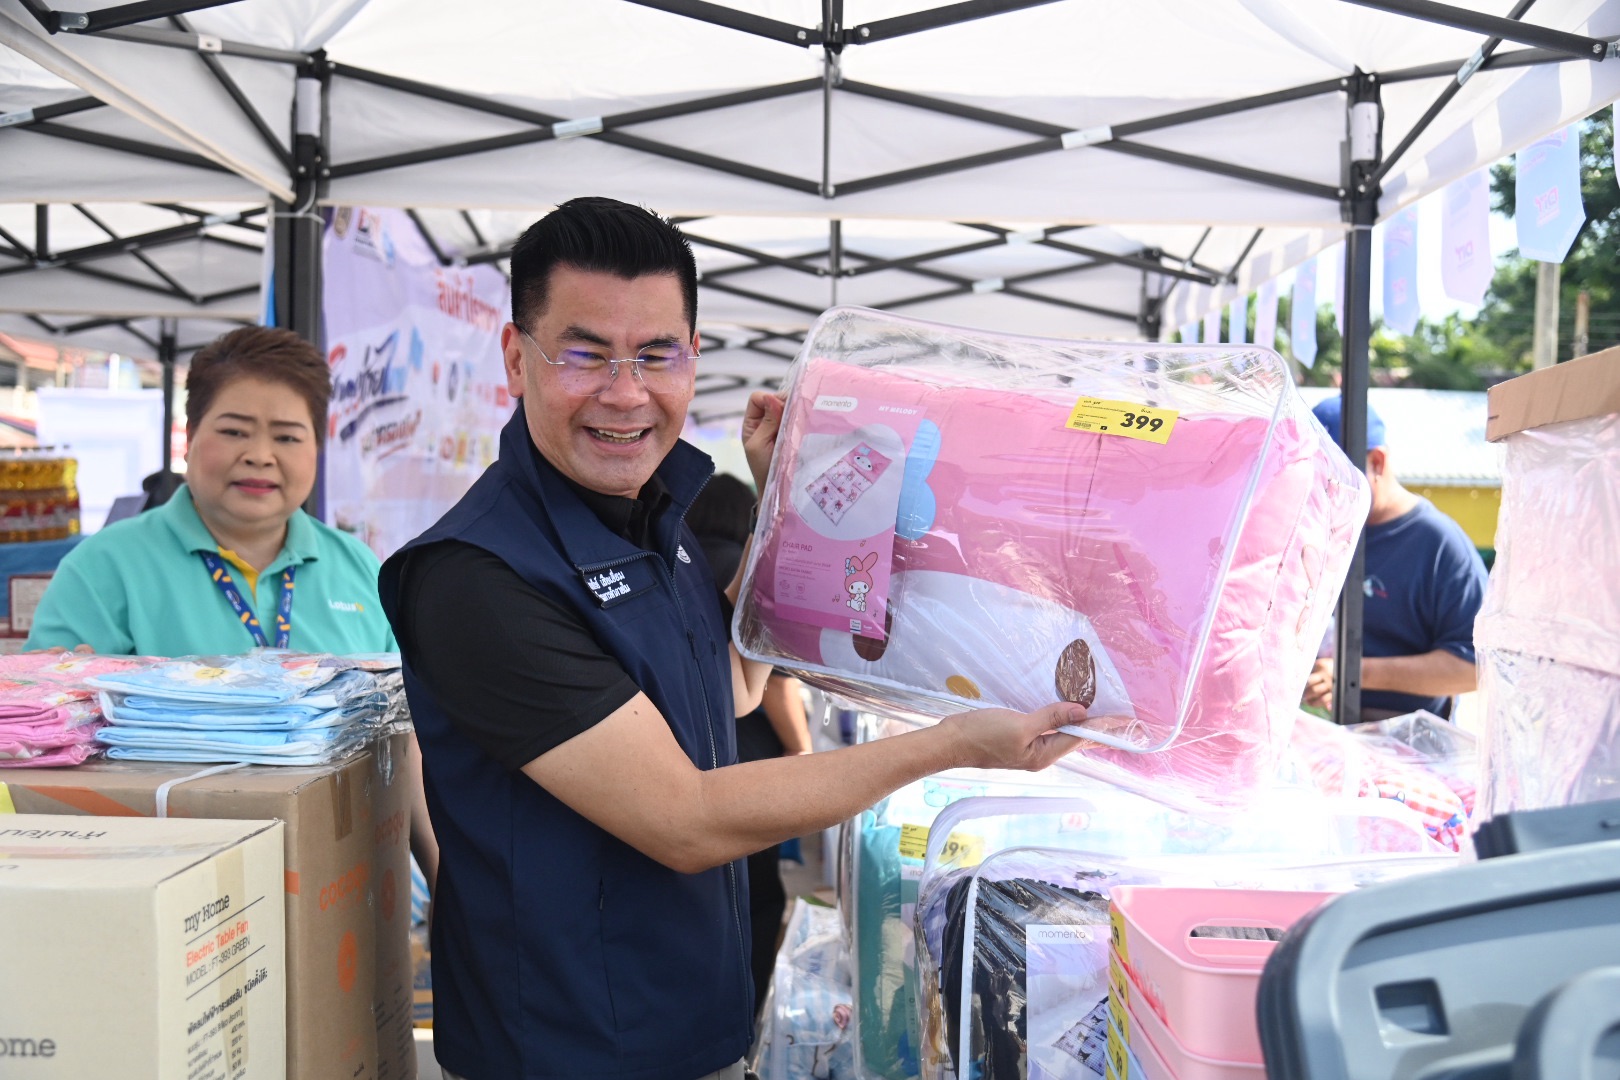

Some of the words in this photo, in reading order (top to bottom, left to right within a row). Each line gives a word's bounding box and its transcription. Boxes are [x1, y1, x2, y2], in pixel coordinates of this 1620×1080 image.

[820, 398, 852, 408] momento
[1120, 412, 1164, 432] 399
[782, 540, 800, 551] CHAIR
[801, 543, 813, 553] PAD
[184, 910, 201, 933] my
[202, 894, 230, 923] Home
[186, 940, 215, 968] Electric
[215, 927, 236, 949] Table
[236, 920, 249, 937] Fan
[1037, 929, 1086, 939] momento
[186, 963, 208, 986] MODEL
[231, 934, 251, 956] GREEN
